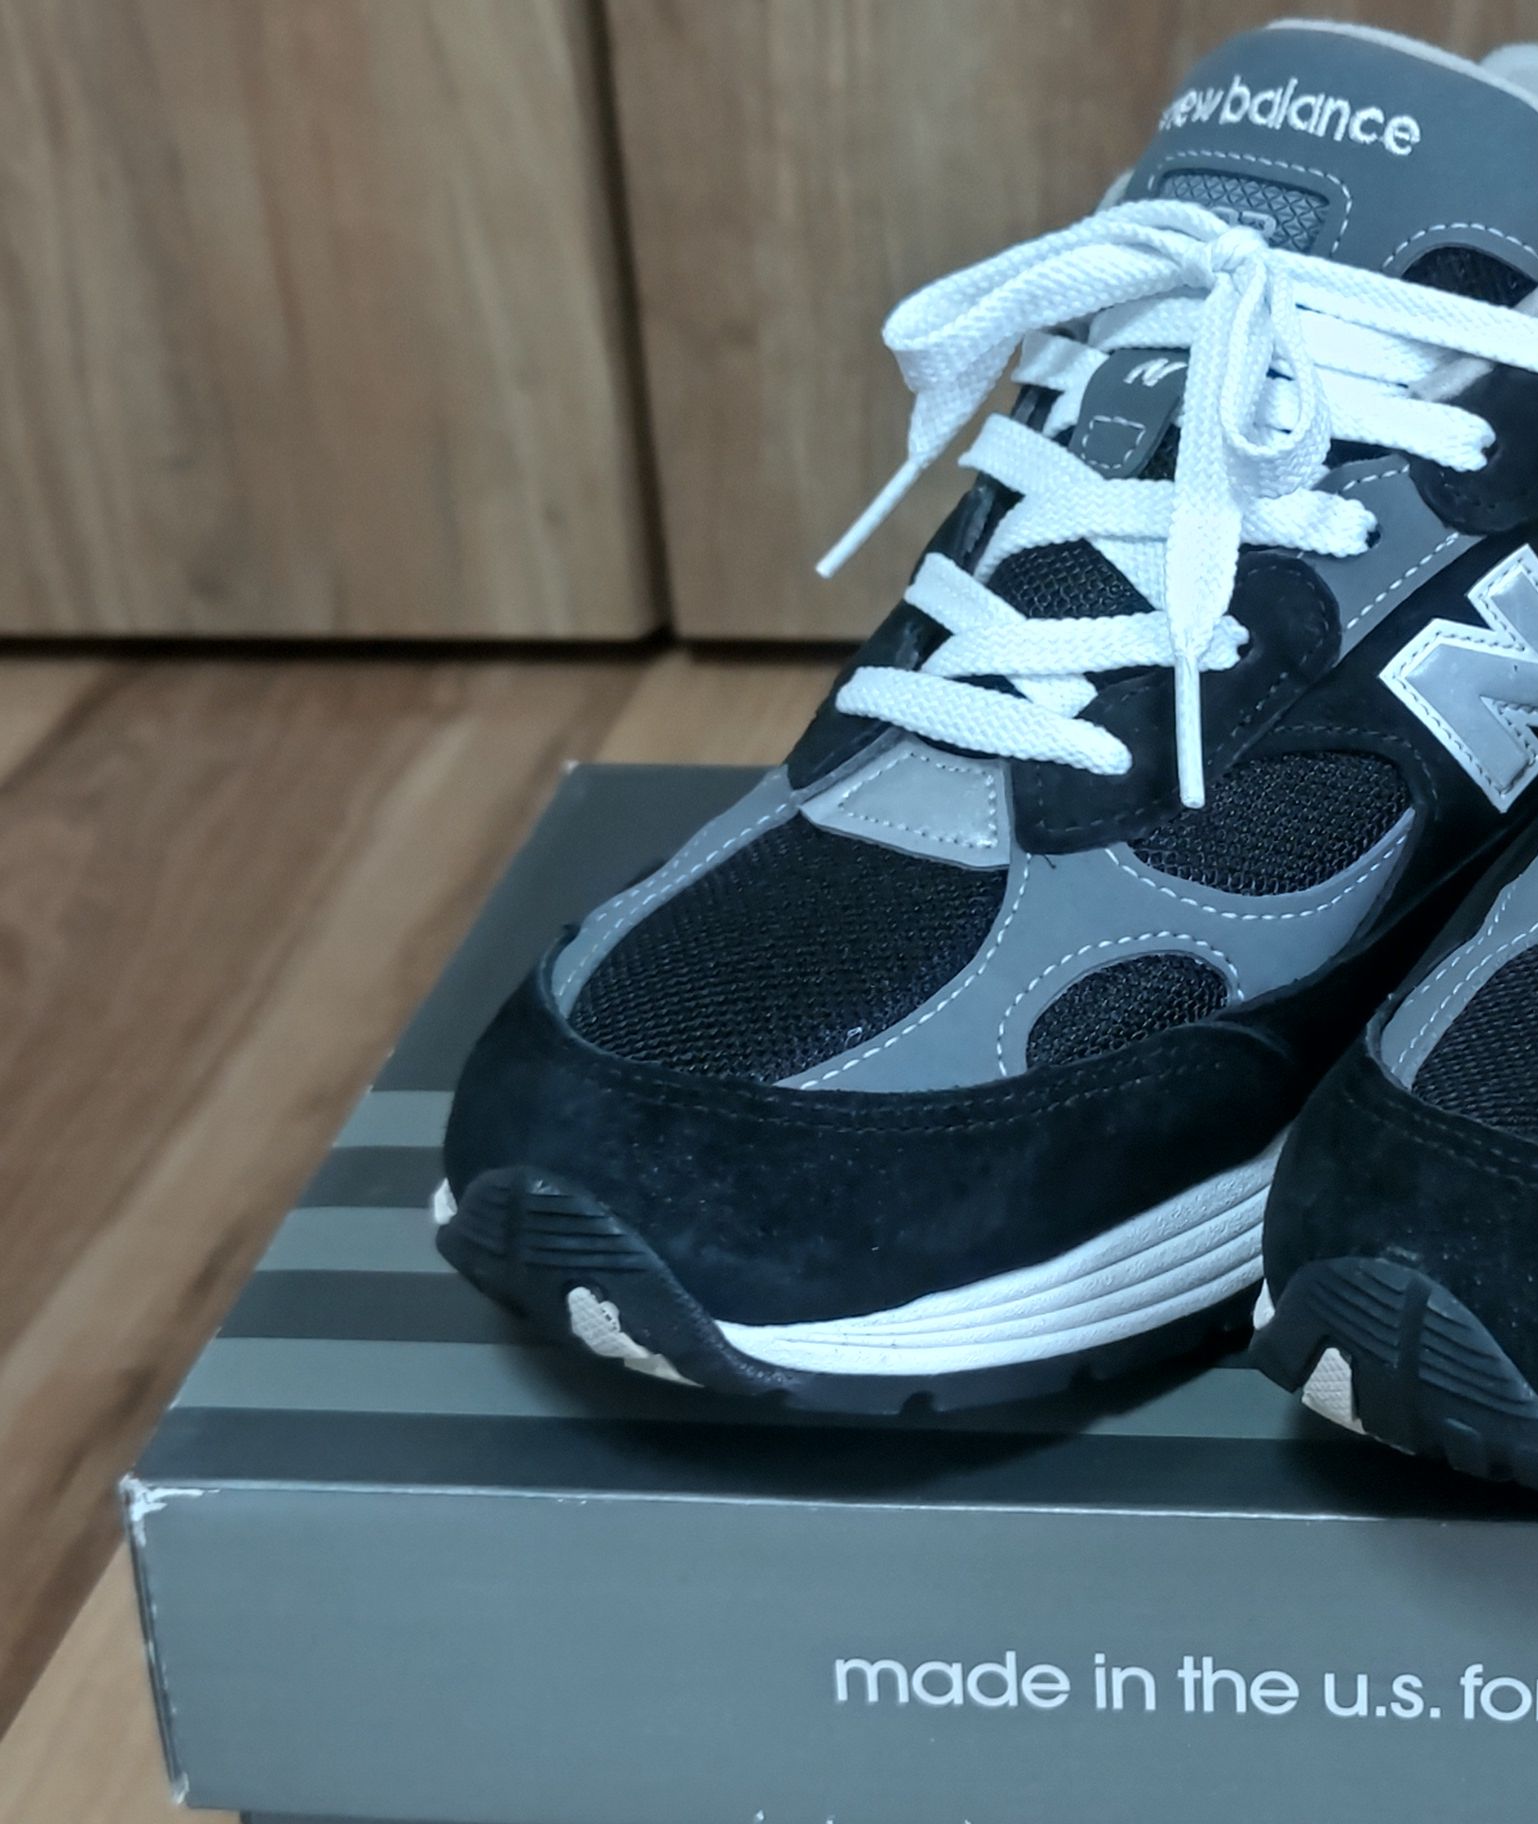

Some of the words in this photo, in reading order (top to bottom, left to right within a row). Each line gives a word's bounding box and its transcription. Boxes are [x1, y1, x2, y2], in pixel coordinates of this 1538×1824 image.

[1219, 74, 1421, 156] balance
[834, 1651, 1070, 1708] made
[1094, 1653, 1156, 1710] in
[1177, 1655, 1299, 1715] the
[1323, 1672, 1441, 1719] u.s.
